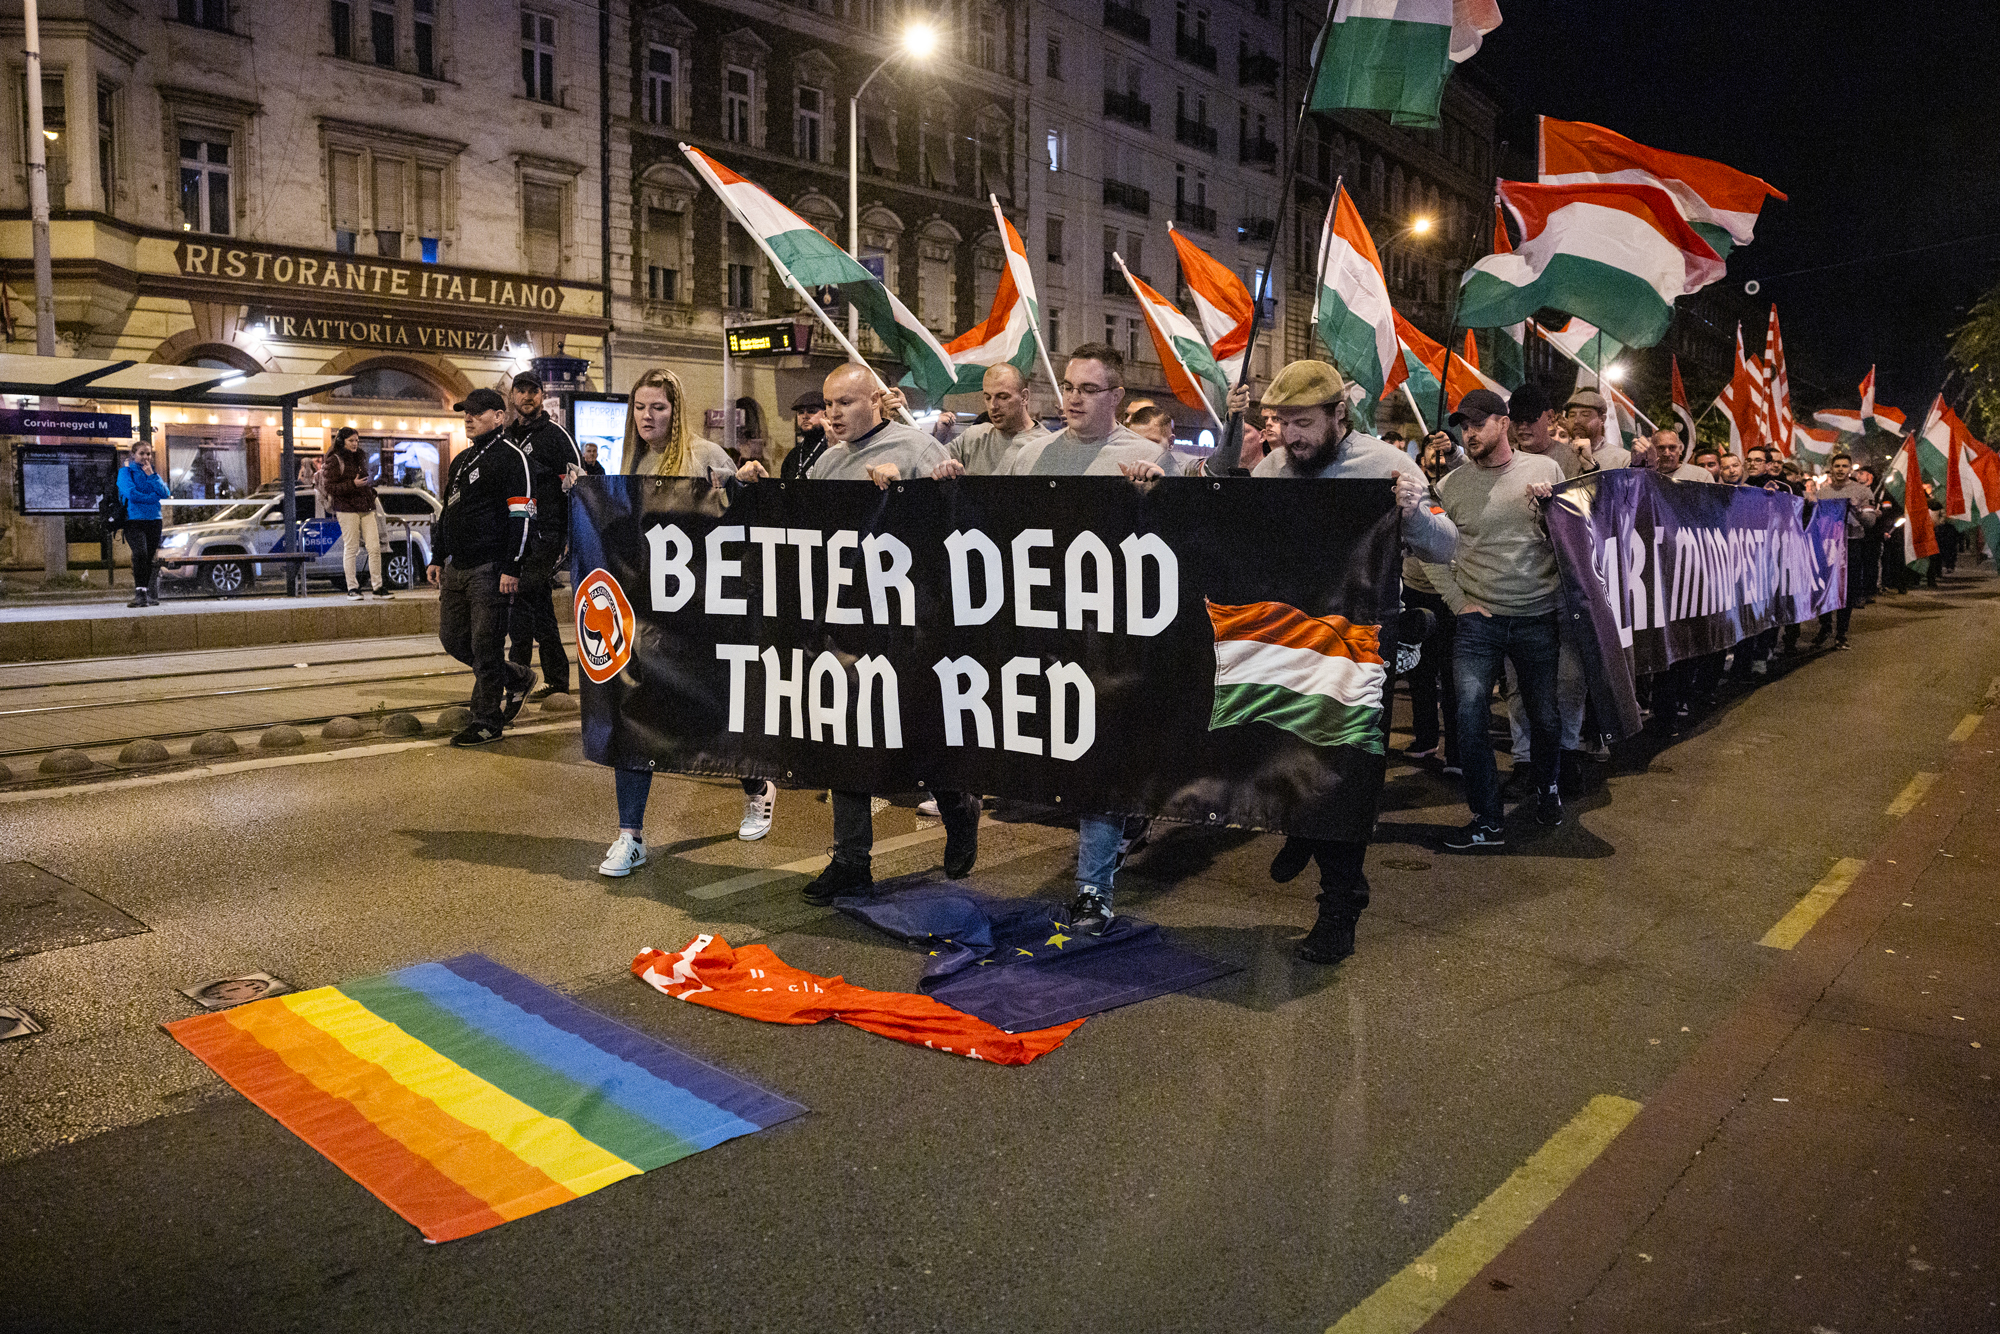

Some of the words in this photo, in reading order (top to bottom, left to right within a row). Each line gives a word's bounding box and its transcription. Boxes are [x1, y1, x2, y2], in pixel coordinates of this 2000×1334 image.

[185, 244, 410, 295] RISTORANTE
[420, 272, 556, 310] ITALIANO
[265, 315, 409, 345] TRATTORIA
[418, 327, 512, 352] VENEZIA
[24, 419, 95, 431] Corvin-negyed
[99, 421, 108, 429] M
[645, 523, 916, 628] BETTER
[944, 528, 1179, 637] DEAD
[588, 655, 608, 665] AKTION
[715, 644, 904, 750] THAN
[932, 656, 1096, 762] RED
